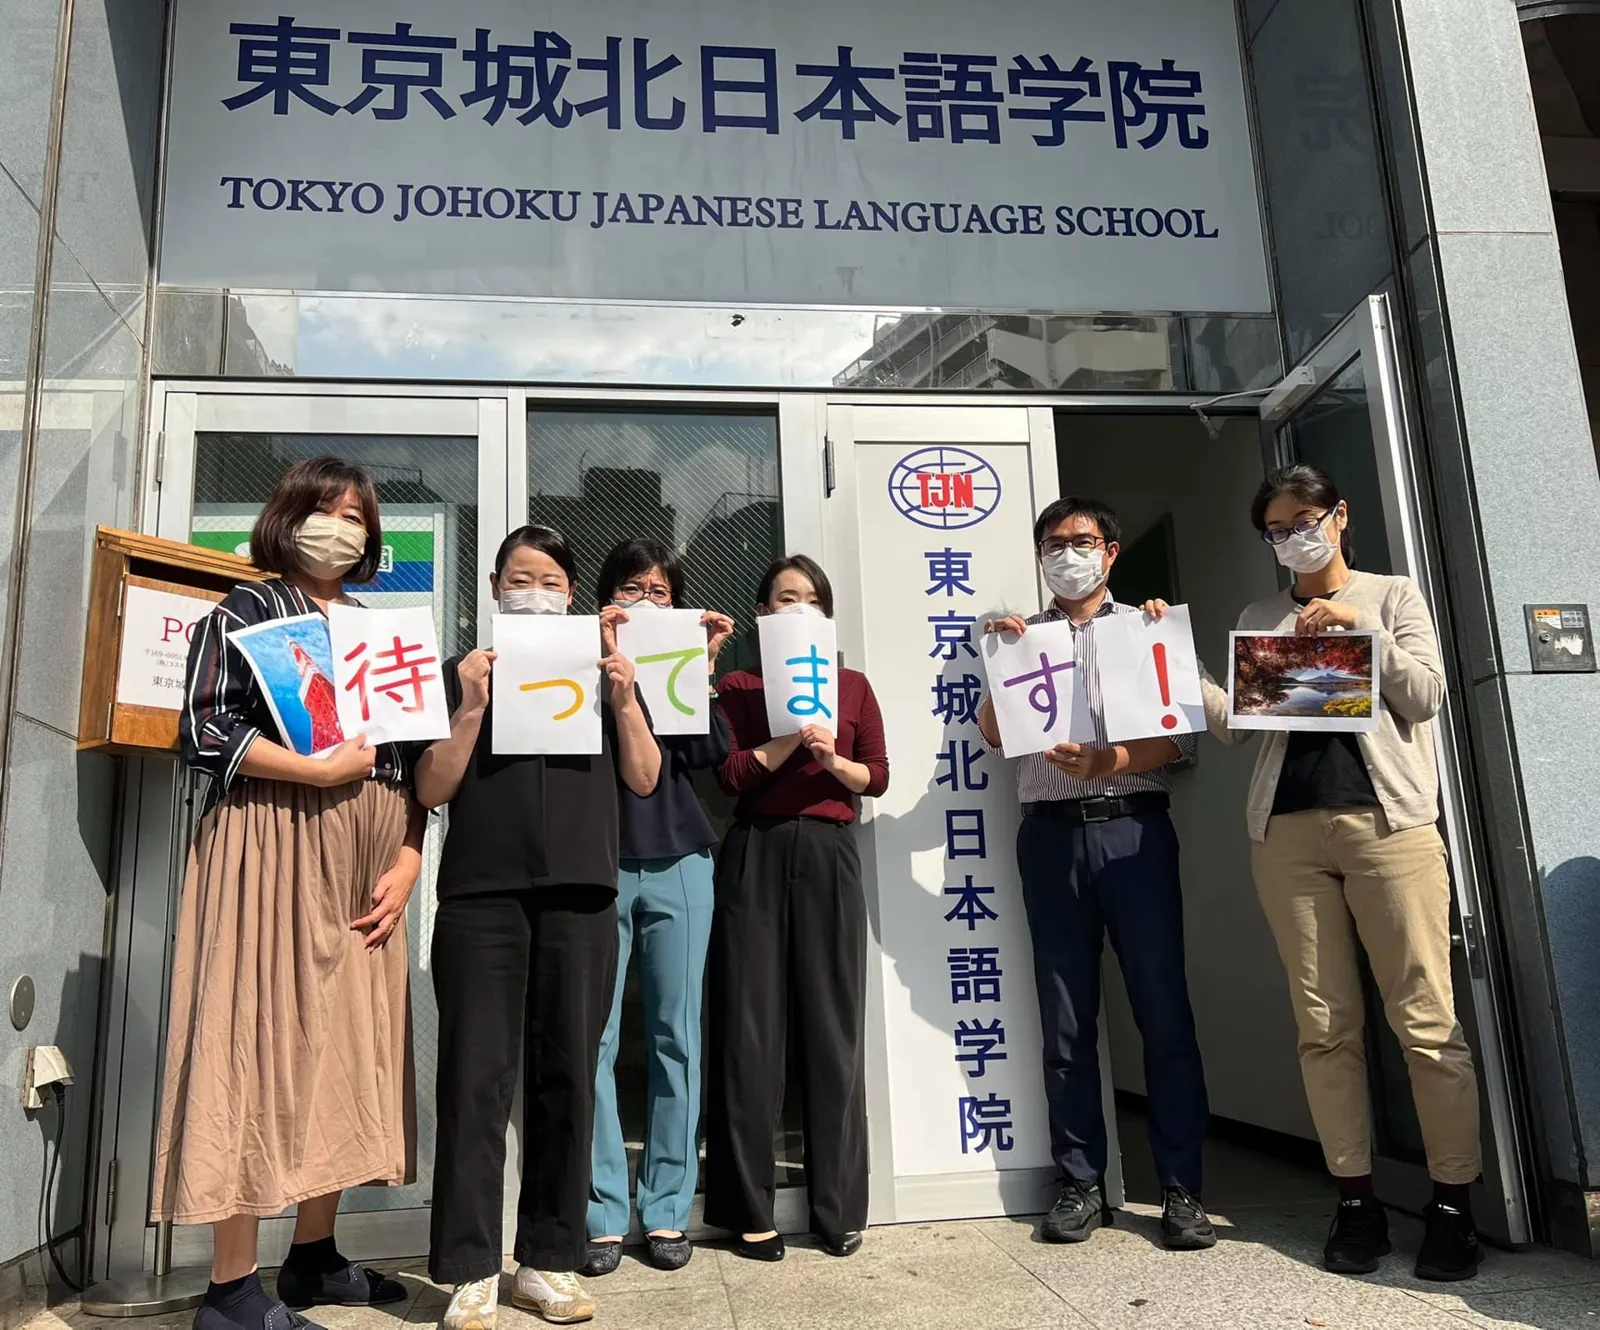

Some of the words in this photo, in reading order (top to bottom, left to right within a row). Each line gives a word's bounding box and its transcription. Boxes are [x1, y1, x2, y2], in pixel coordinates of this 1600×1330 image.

[221, 15, 1209, 150] 東京城北日本語学院
[220, 176, 385, 214] TOKYO
[393, 184, 582, 222] JOHOKU
[590, 191, 804, 229] JAPANESE
[814, 199, 1046, 235] LANGUAGE
[1055, 205, 1219, 239] SCHOOL
[916, 472, 975, 509] TJN
[344, 636, 437, 721] 待
[634, 646, 705, 716] て
[785, 644, 832, 719] ま
[1003, 652, 1077, 732] す
[924, 546, 1014, 1155] 東京城北日本語学院
